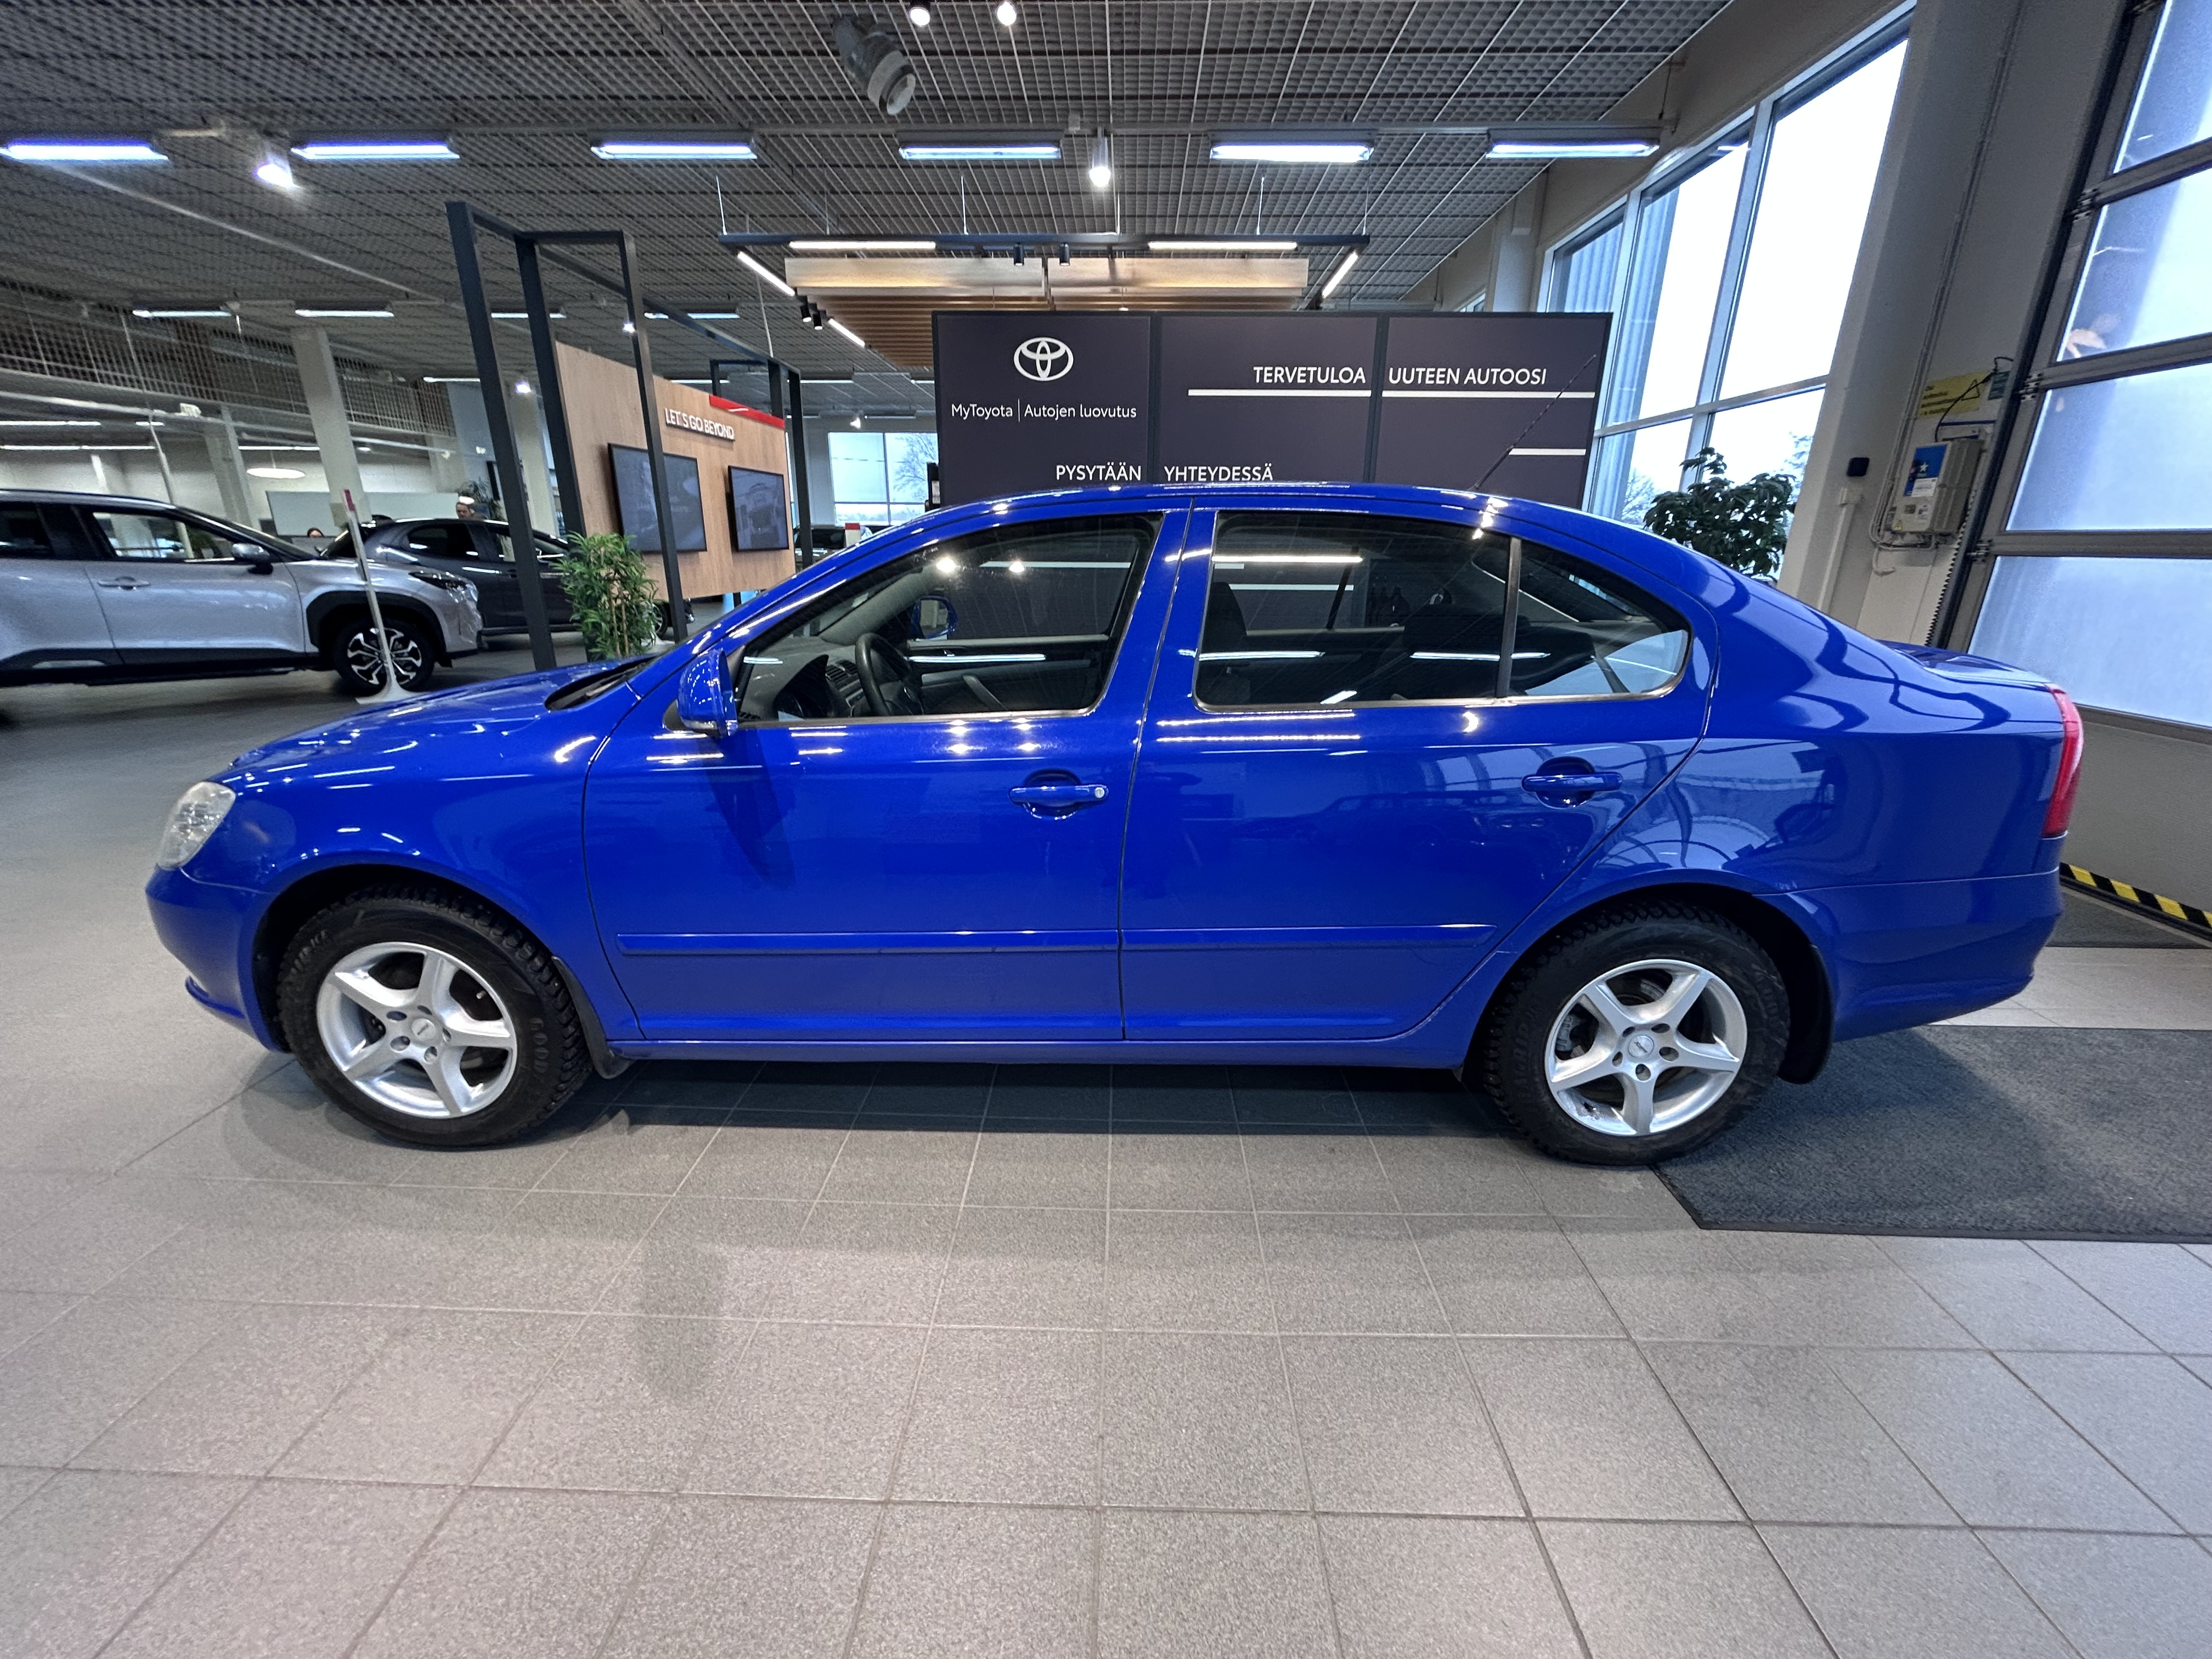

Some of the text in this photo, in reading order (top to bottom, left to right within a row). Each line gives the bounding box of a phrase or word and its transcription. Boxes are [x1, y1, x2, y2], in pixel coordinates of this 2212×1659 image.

[1253, 366, 1547, 385] TERVETULOA UUTEEN AUTOOSI
[951, 403, 1137, 421] MyToyota Autojen luovutus
[689, 415, 703, 432] GO
[703, 419, 735, 440] BEYOND
[1056, 461, 1273, 481] PYSYTÄÄN YHTEYDESSÄ
